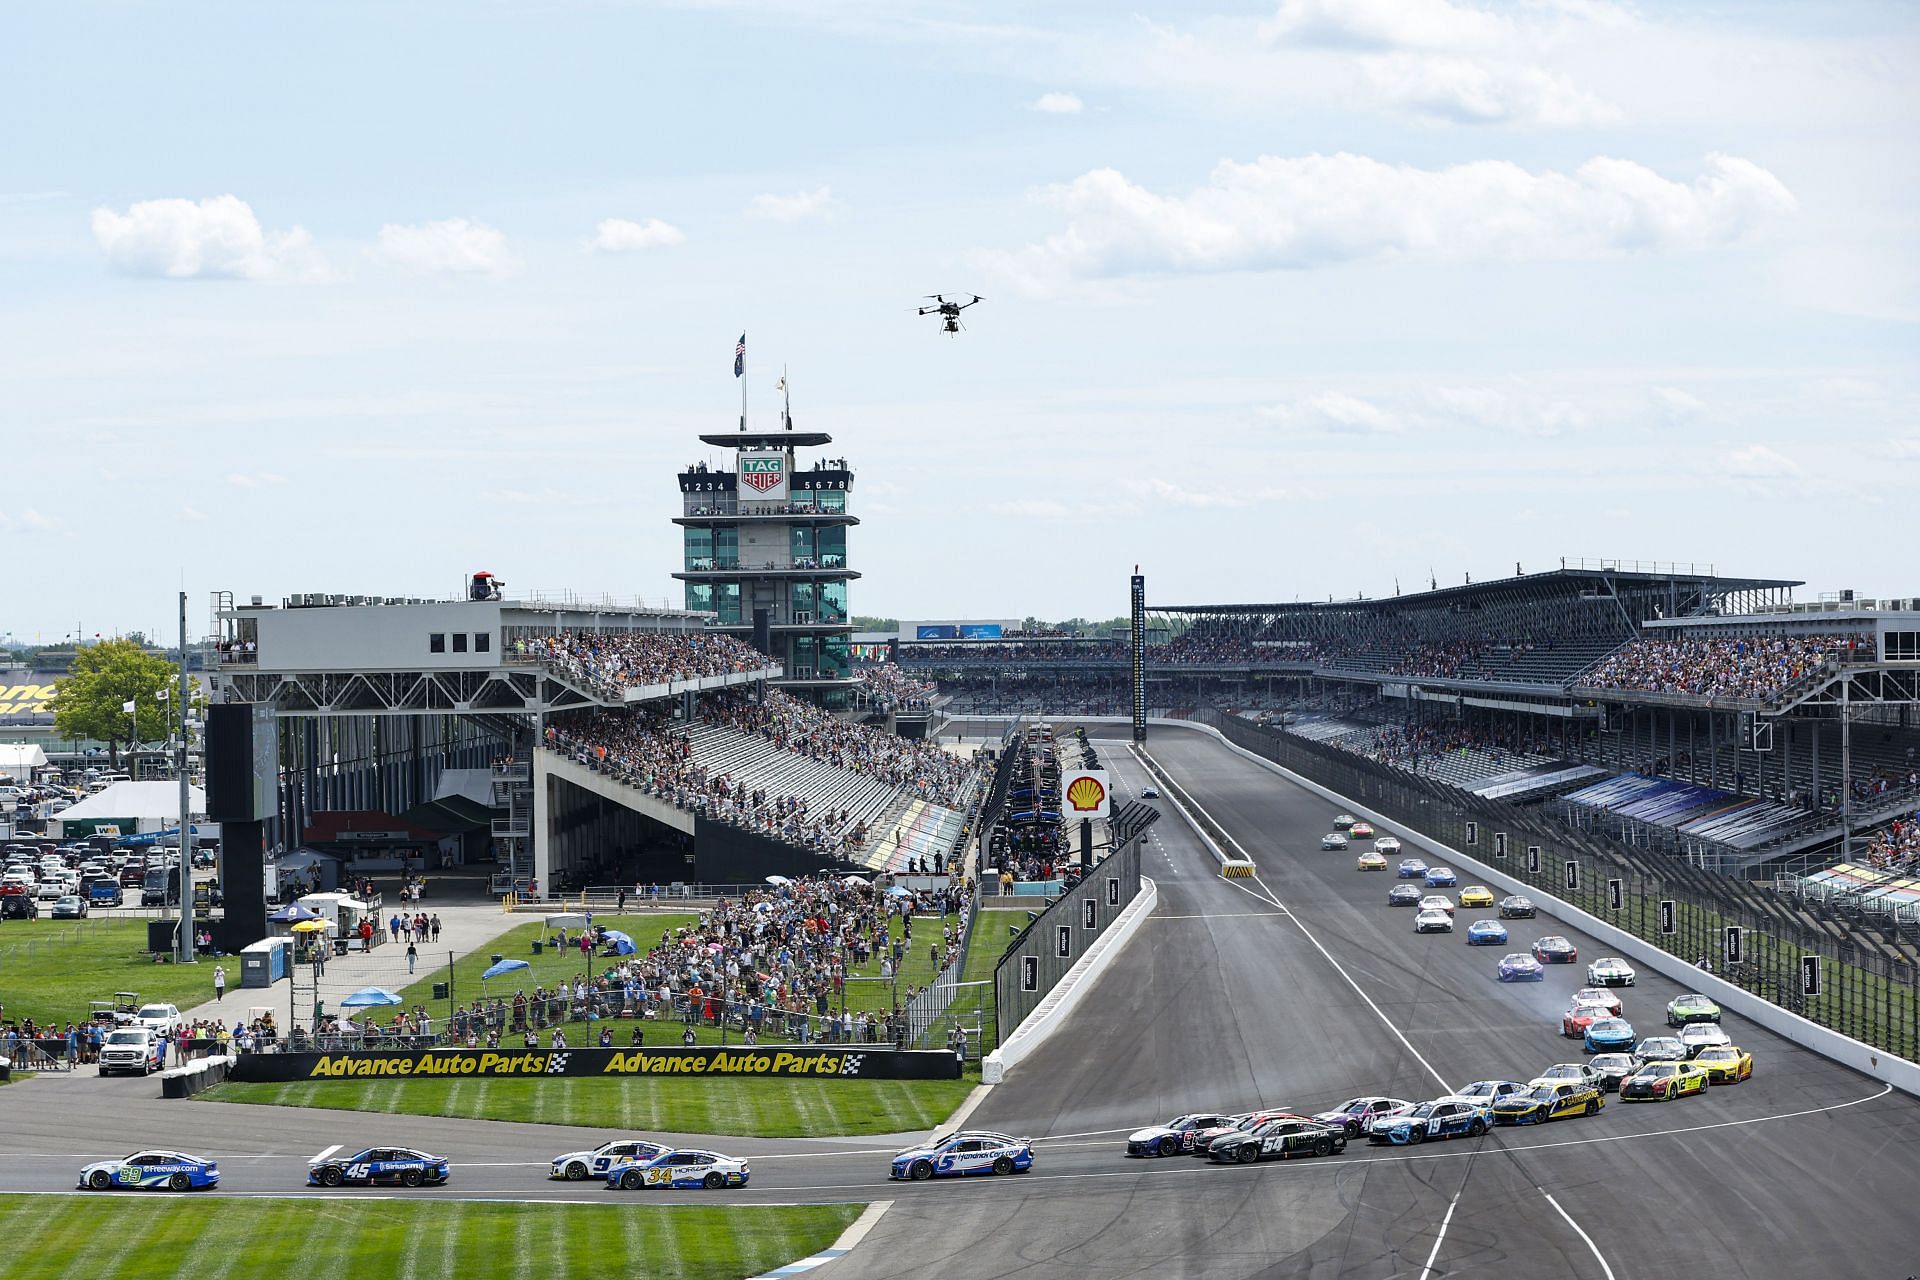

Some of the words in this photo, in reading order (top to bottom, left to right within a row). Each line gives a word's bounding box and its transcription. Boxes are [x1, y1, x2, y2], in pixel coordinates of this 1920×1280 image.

[745, 461, 779, 471] TAG
[695, 483, 701, 491] 2
[706, 482, 713, 490] 3
[717, 482, 724, 490] 4
[744, 473, 780, 489] HEUER
[815, 481, 822, 489] 6
[827, 481, 833, 489] 7
[838, 481, 845, 489] 8
[309, 1055, 412, 1077] Advance
[412, 1053, 476, 1074] Auto
[477, 1052, 545, 1073] Parts
[603, 1052, 706, 1073] Advance
[706, 1052, 770, 1073] Auto
[771, 1052, 840, 1074] Parts
[1678, 1077, 1687, 1090] 12
[1426, 1118, 1442, 1133] 19
[1262, 1136, 1284, 1152] 54
[149, 1165, 198, 1173] Freeway.com
[593, 1157, 612, 1171] 9
[937, 1153, 956, 1170] 5
[118, 1166, 143, 1183] 99
[346, 1163, 372, 1178] 45
[647, 1167, 673, 1184] 34
